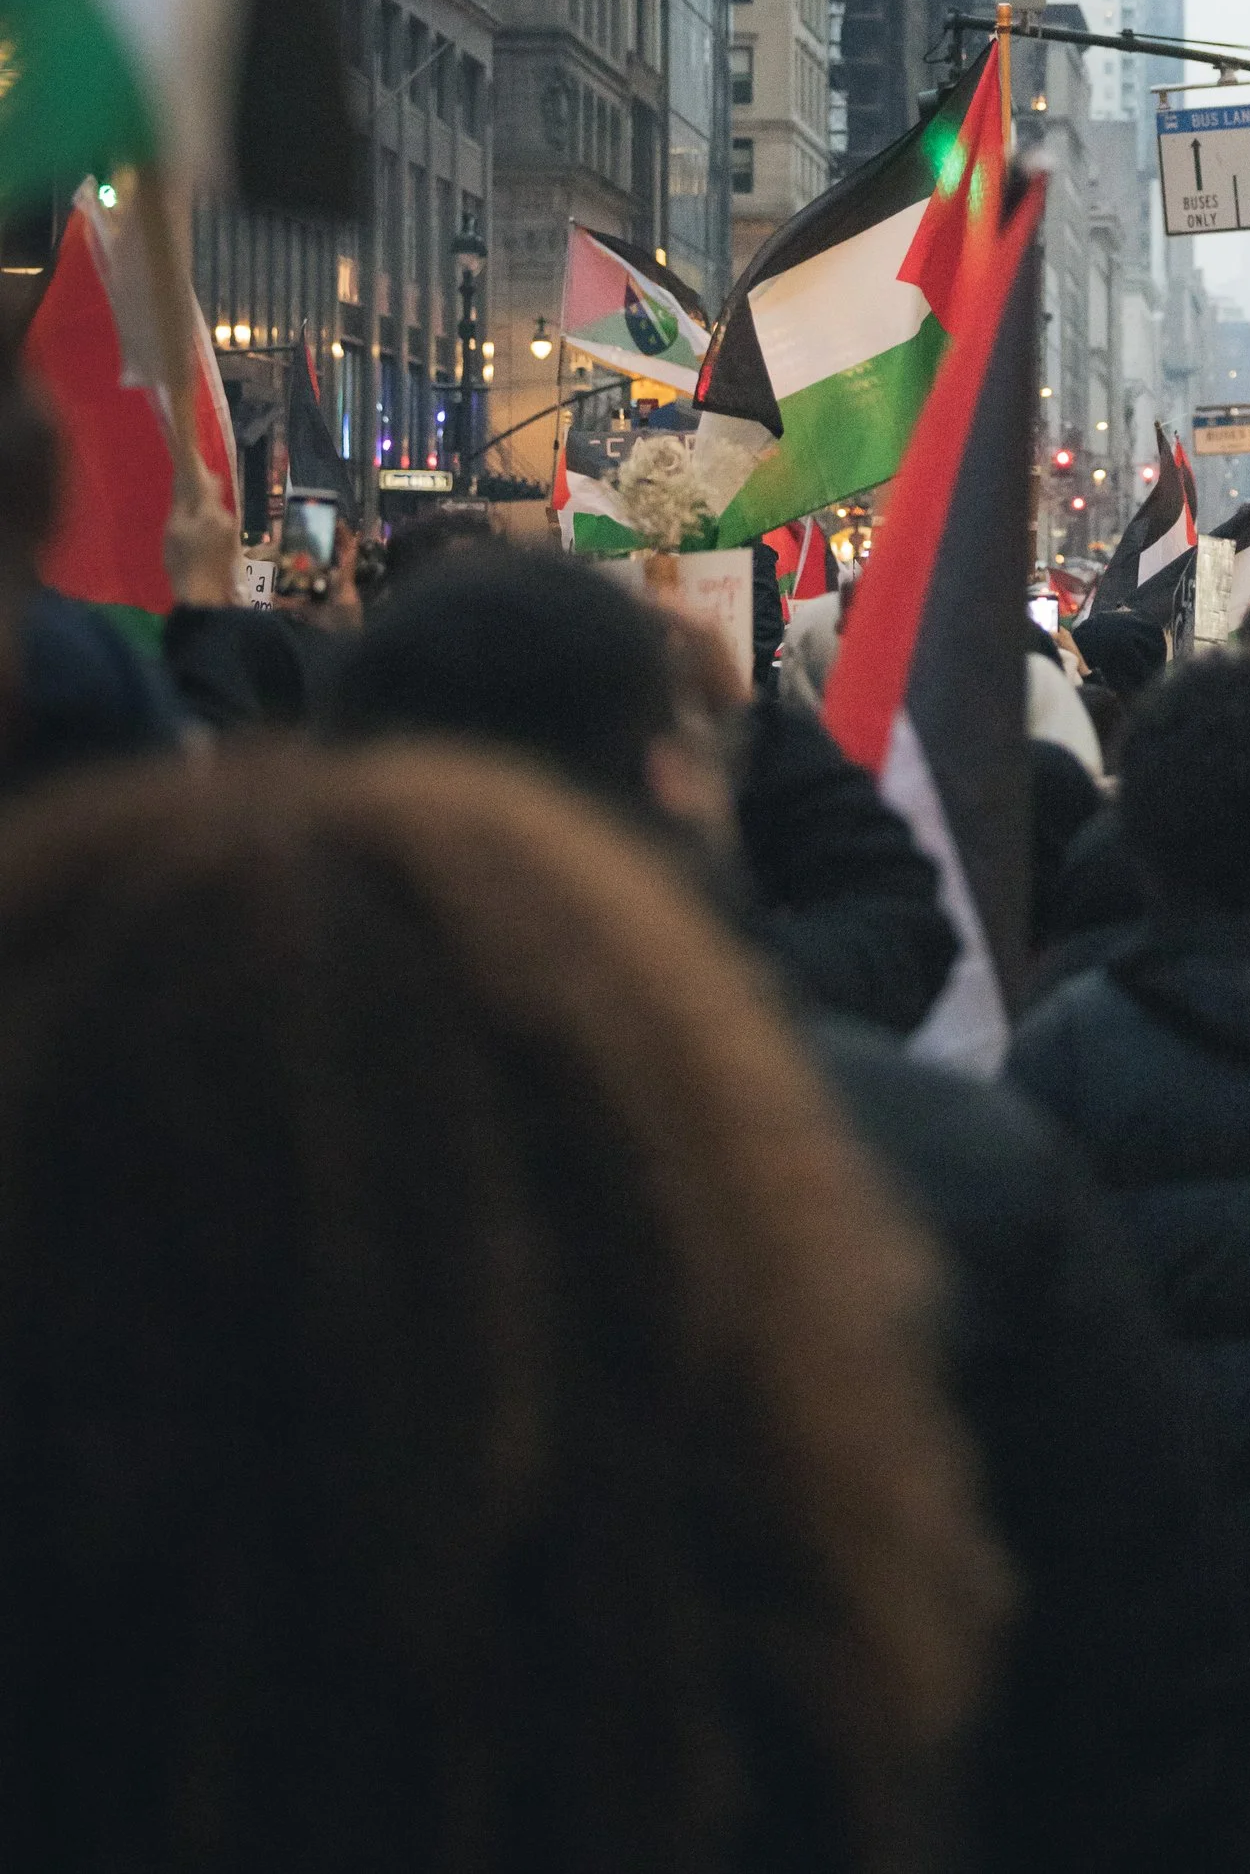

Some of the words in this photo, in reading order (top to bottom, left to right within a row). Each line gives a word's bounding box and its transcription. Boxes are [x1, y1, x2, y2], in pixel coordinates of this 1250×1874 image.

[1191, 113, 1219, 128] BUS
[1183, 194, 1219, 210] BUSES
[1187, 213, 1217, 228] ONLY
